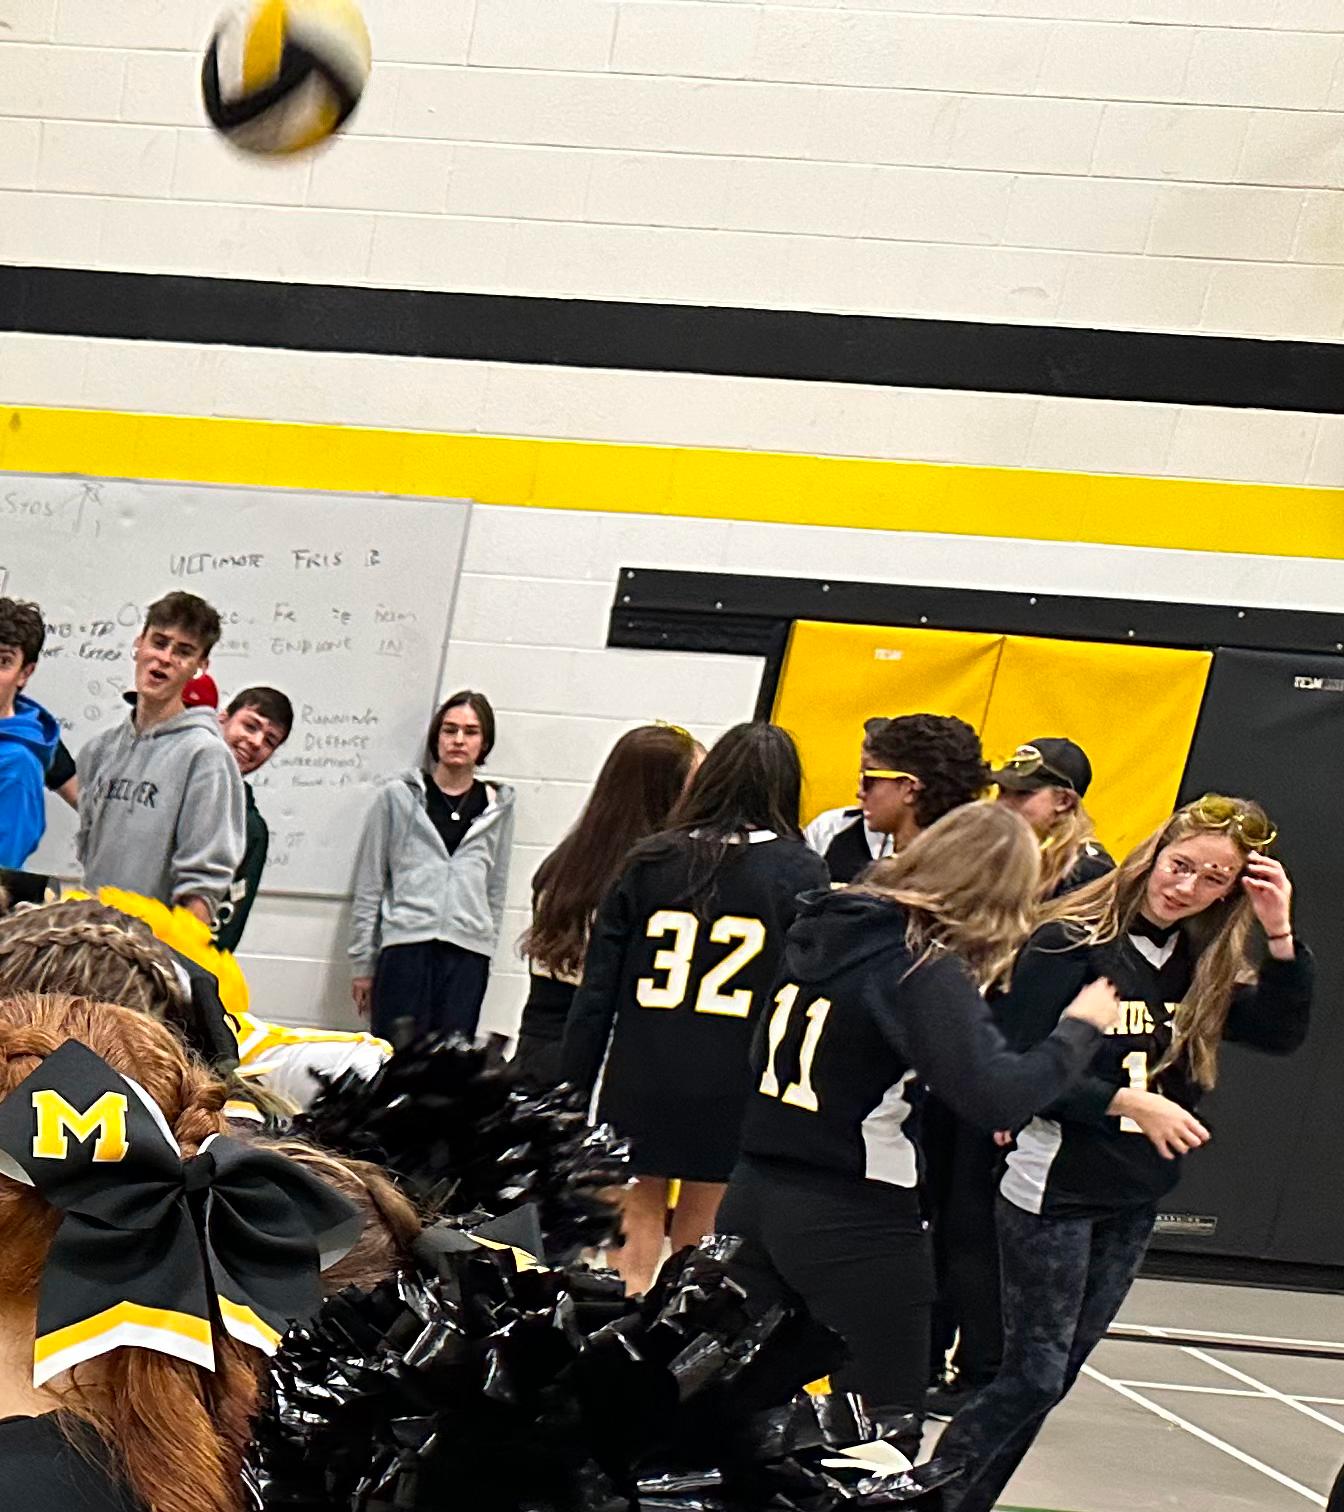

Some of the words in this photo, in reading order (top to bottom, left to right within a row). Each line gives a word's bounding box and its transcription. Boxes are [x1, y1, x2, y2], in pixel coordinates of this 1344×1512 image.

[636, 910, 766, 1018] 32
[759, 983, 831, 1112] 11
[31, 1089, 130, 1163] M
